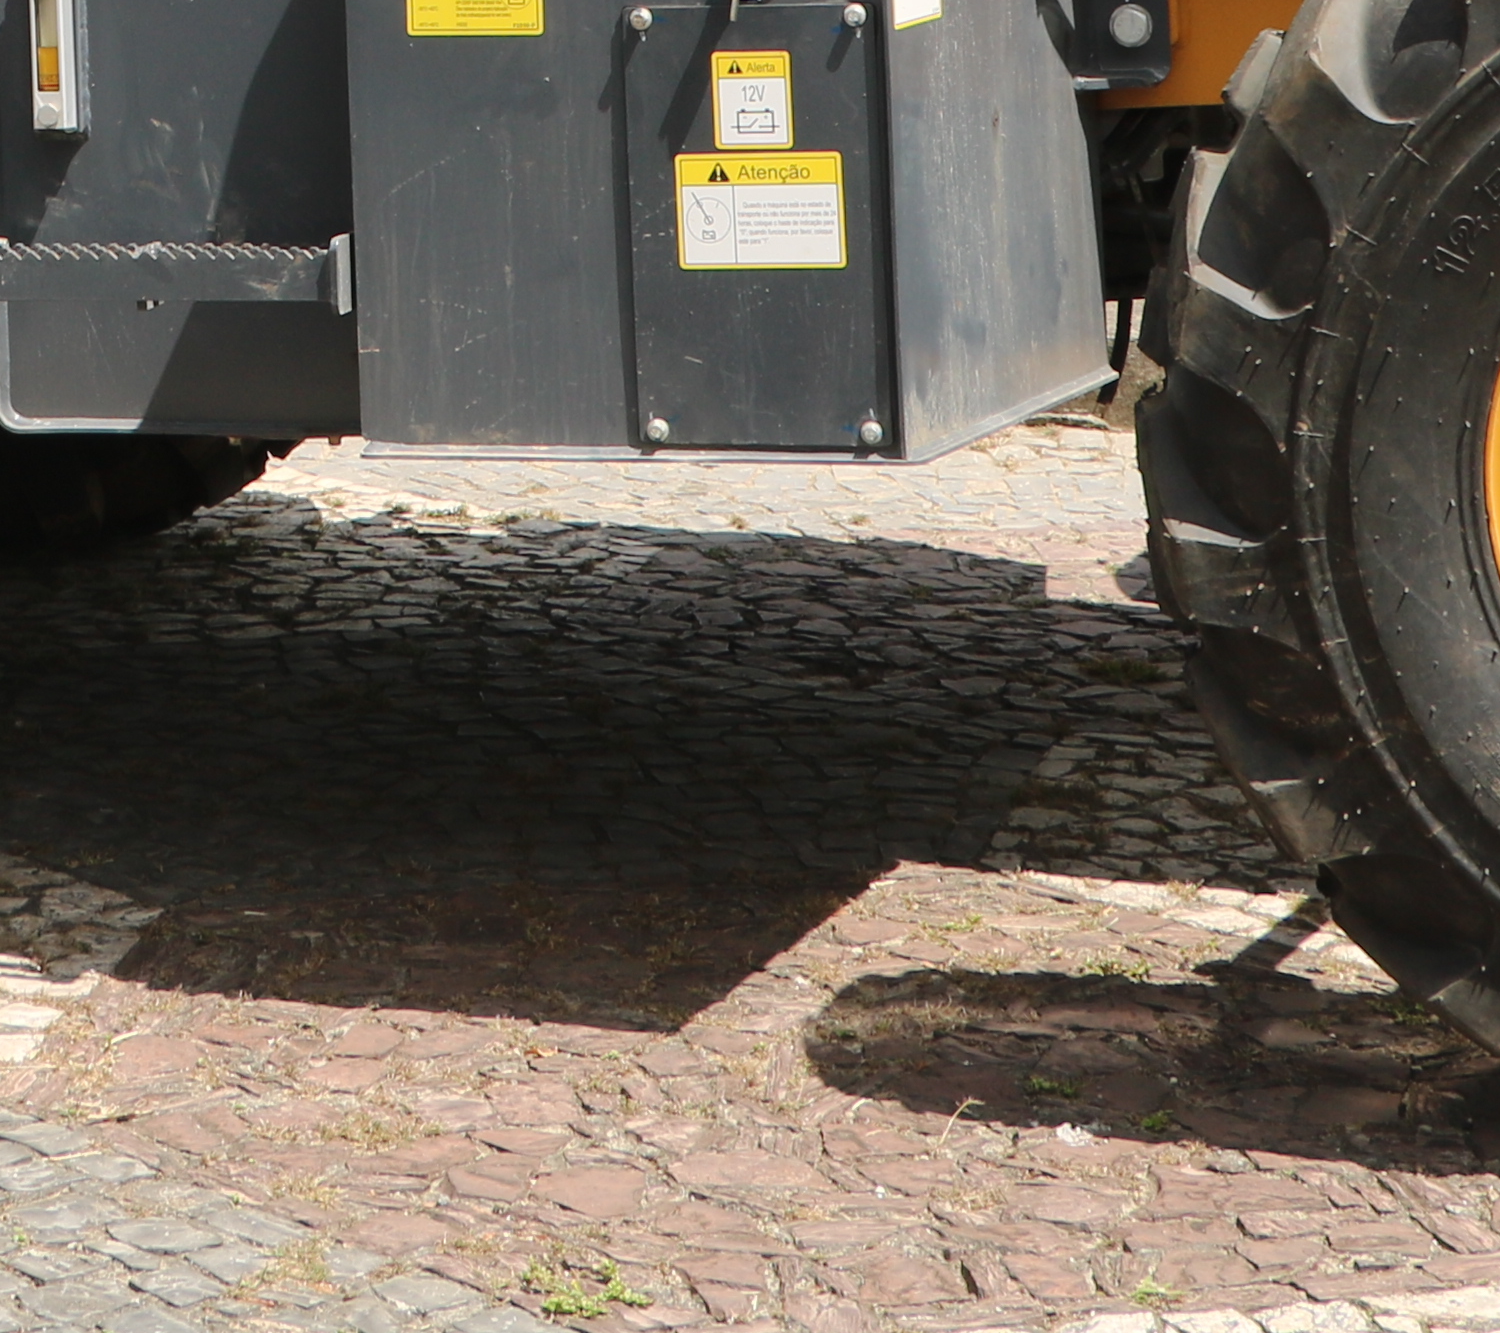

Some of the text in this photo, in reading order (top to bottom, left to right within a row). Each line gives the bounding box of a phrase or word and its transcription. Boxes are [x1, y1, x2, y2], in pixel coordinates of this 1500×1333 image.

[746, 63, 776, 73] Alerta
[741, 85, 766, 102] 12V
[737, 164, 811, 183] Atenção
